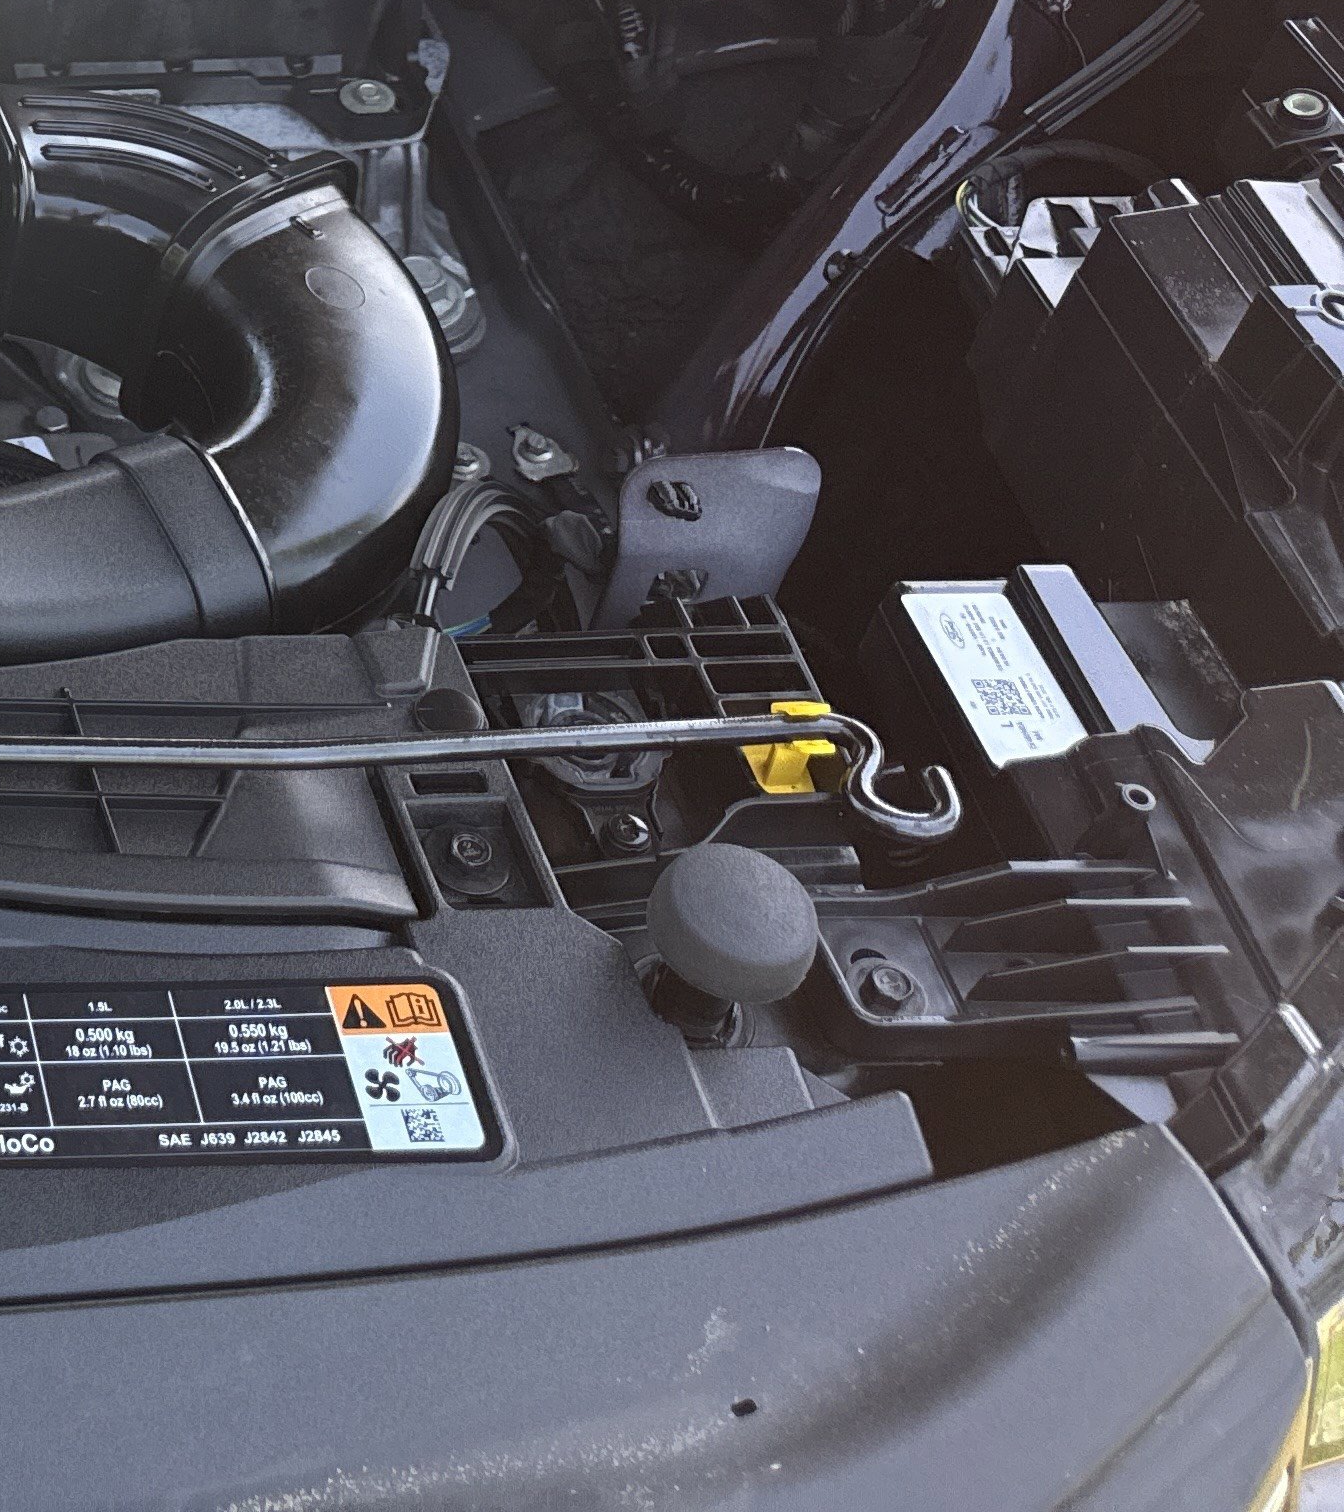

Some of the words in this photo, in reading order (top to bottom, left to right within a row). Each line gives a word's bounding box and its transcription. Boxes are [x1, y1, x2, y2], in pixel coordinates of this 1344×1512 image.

[87, 1001, 113, 1013] 1.5L
[223, 999, 249, 1011] 2.0L
[256, 998, 282, 1010] 2.3L
[75, 1027, 113, 1042] 0.500
[115, 1028, 135, 1045] kg
[229, 1023, 266, 1038] 0.550
[269, 1023, 288, 1040] kg
[65, 1046, 80, 1057] 18
[83, 1047, 97, 1057] oz
[99, 1045, 127, 1059] (1.10
[129, 1044, 153, 1058] lbs)
[214, 1041, 240, 1054] 19.5
[242, 1043, 257, 1054] oz
[258, 1040, 286, 1055] (1.21
[288, 1040, 312, 1055] lbs)
[102, 1079, 132, 1092] PAG
[258, 1076, 288, 1089] PAG
[78, 1095, 96, 1108] 2.7
[98, 1095, 108, 1107] fl
[109, 1096, 124, 1107] oz
[126, 1093, 164, 1109] (80cc)
[230, 1093, 249, 1106] 3.4
[251, 1092, 261, 1105] fl
[263, 1093, 278, 1104] oz
[279, 1090, 324, 1107] (100cc)
[158, 1133, 193, 1147] SAE
[200, 1131, 236, 1146] J639
[243, 1130, 288, 1145] J2842
[297, 1128, 341, 1144] J2845
